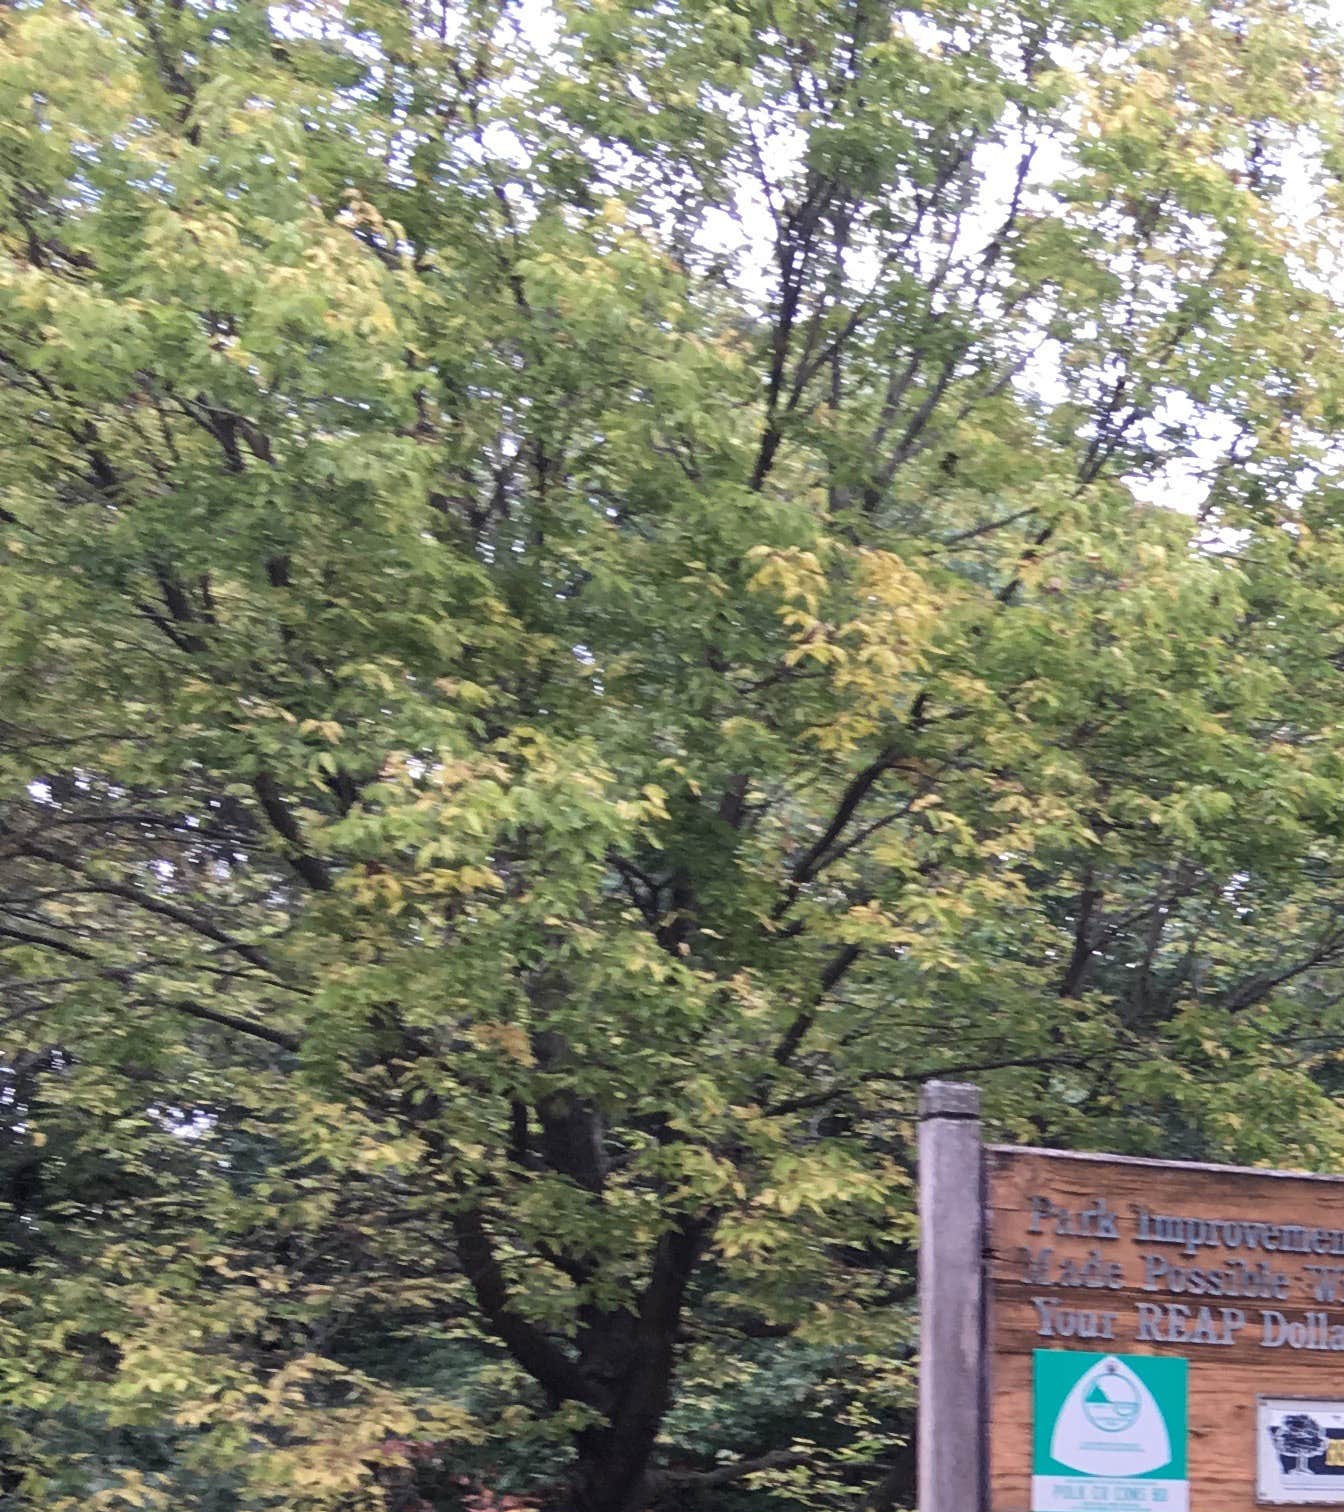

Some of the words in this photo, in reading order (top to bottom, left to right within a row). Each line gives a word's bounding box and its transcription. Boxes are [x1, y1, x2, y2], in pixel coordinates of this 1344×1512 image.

[1028, 1196, 1119, 1239] Park
[1018, 1246, 1126, 1289] Made
[1139, 1253, 1289, 1300] Possible
[1032, 1297, 1117, 1339] Your
[1135, 1302, 1245, 1345] REAP
